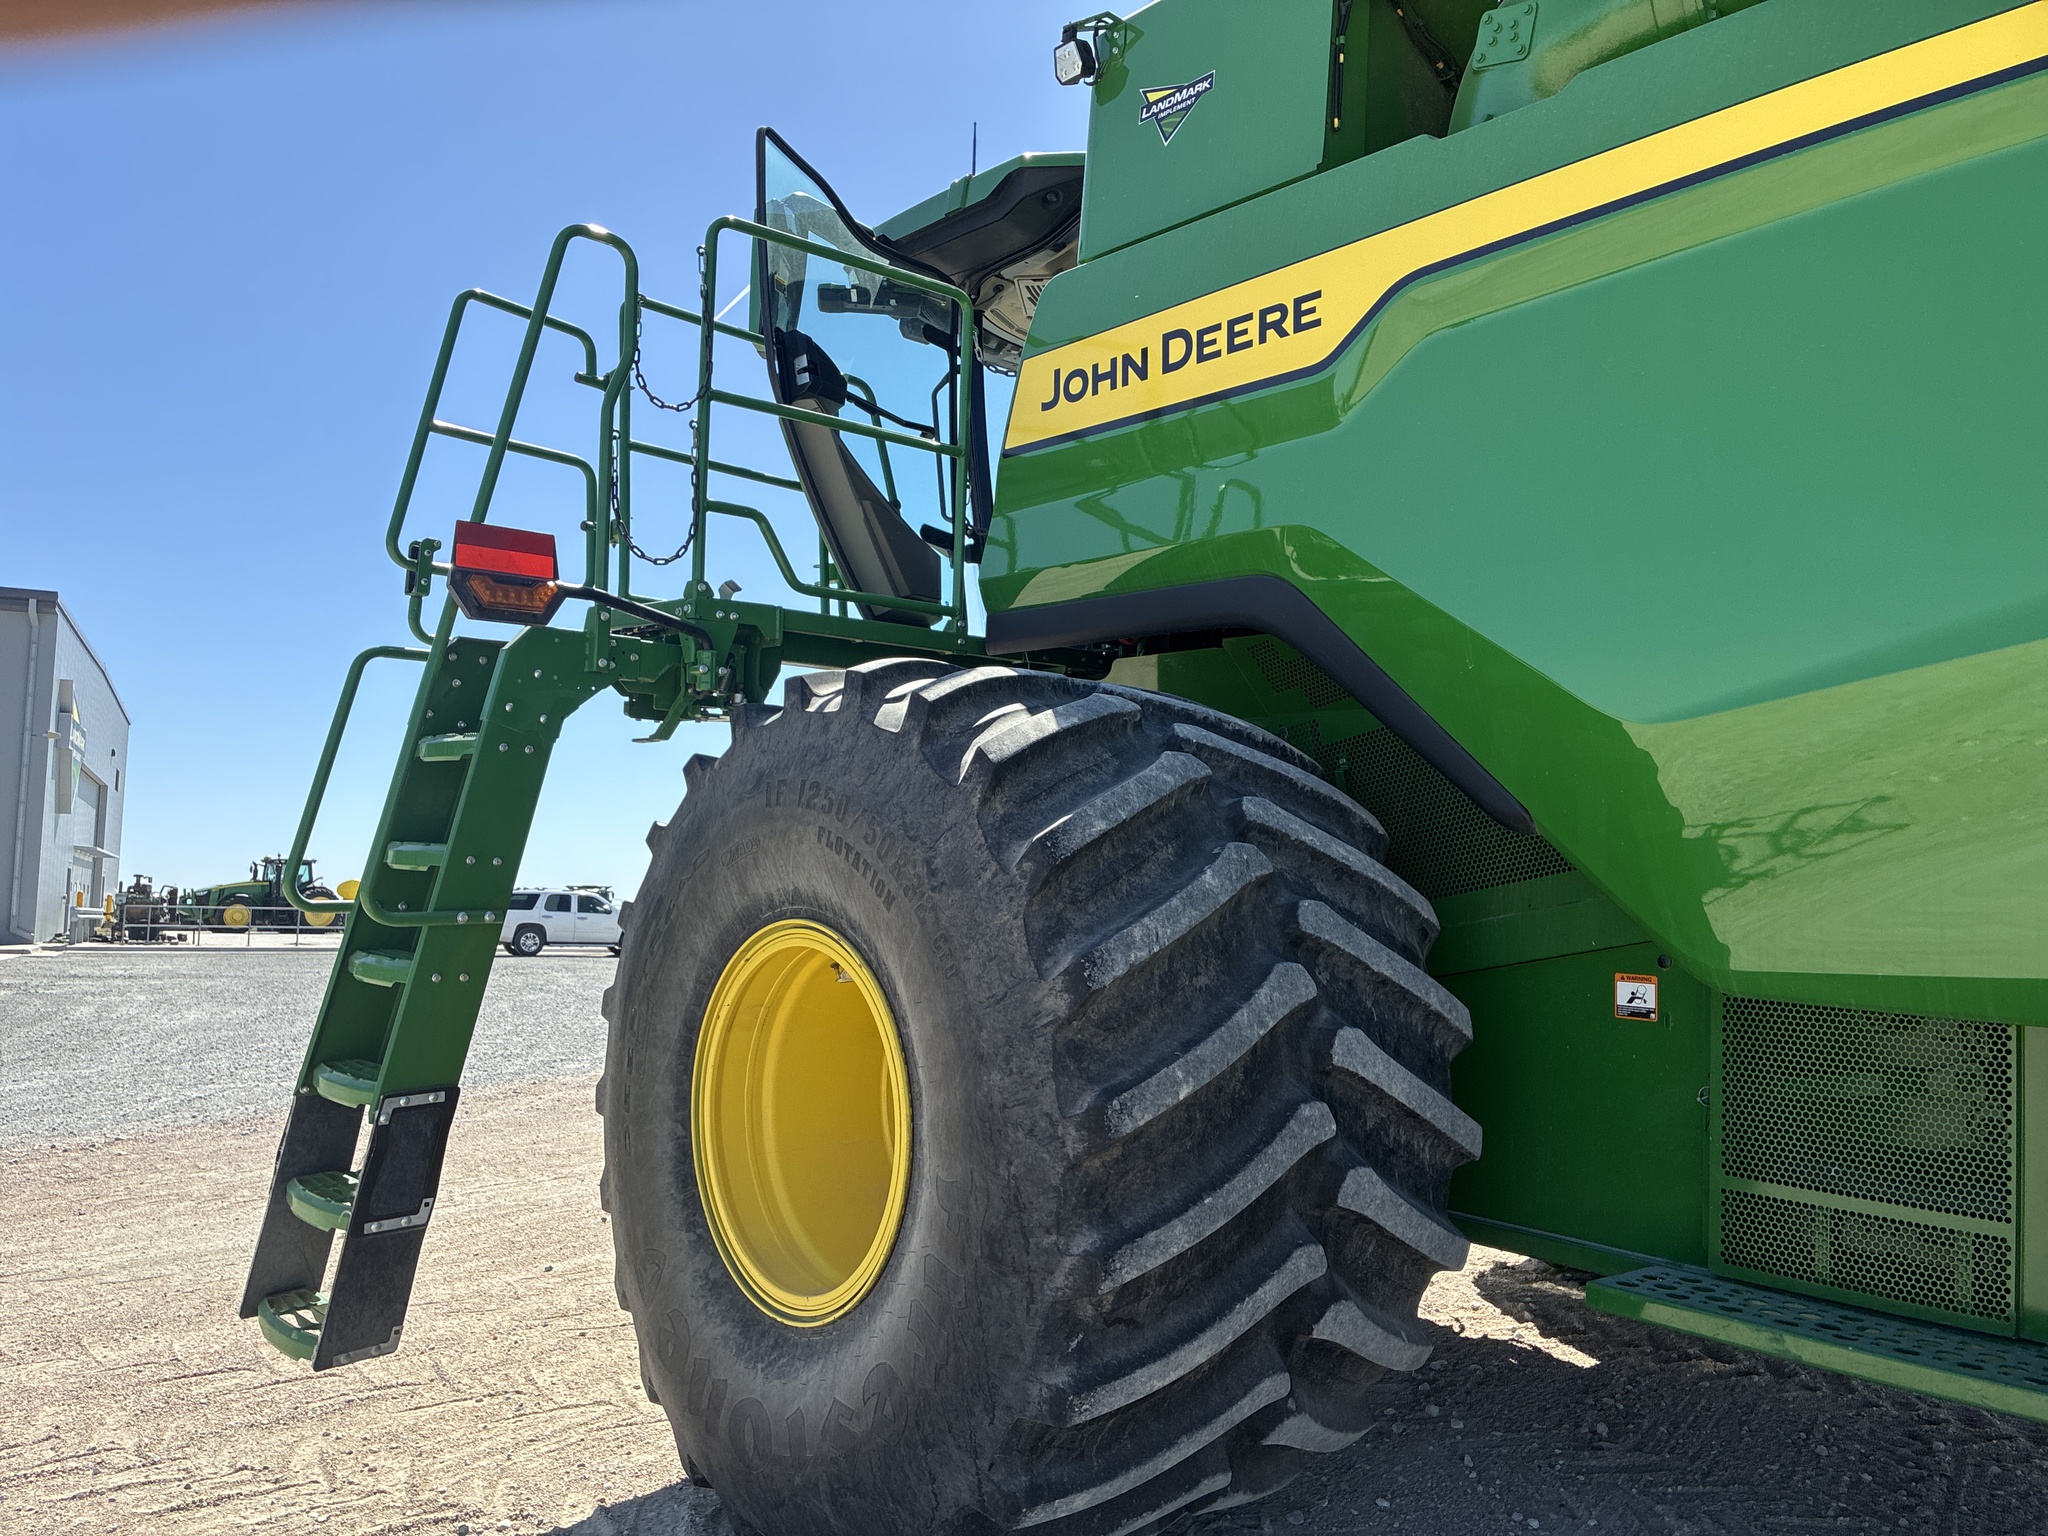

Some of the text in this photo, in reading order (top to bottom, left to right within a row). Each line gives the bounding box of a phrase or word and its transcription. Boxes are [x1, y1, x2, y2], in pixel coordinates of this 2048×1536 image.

[1141, 77, 1212, 120] LANDMARK
[1157, 96, 1197, 119] IMPLEMENT
[1041, 289, 1322, 412] JOHN DEERE
[816, 825, 897, 914] FLOTATION
